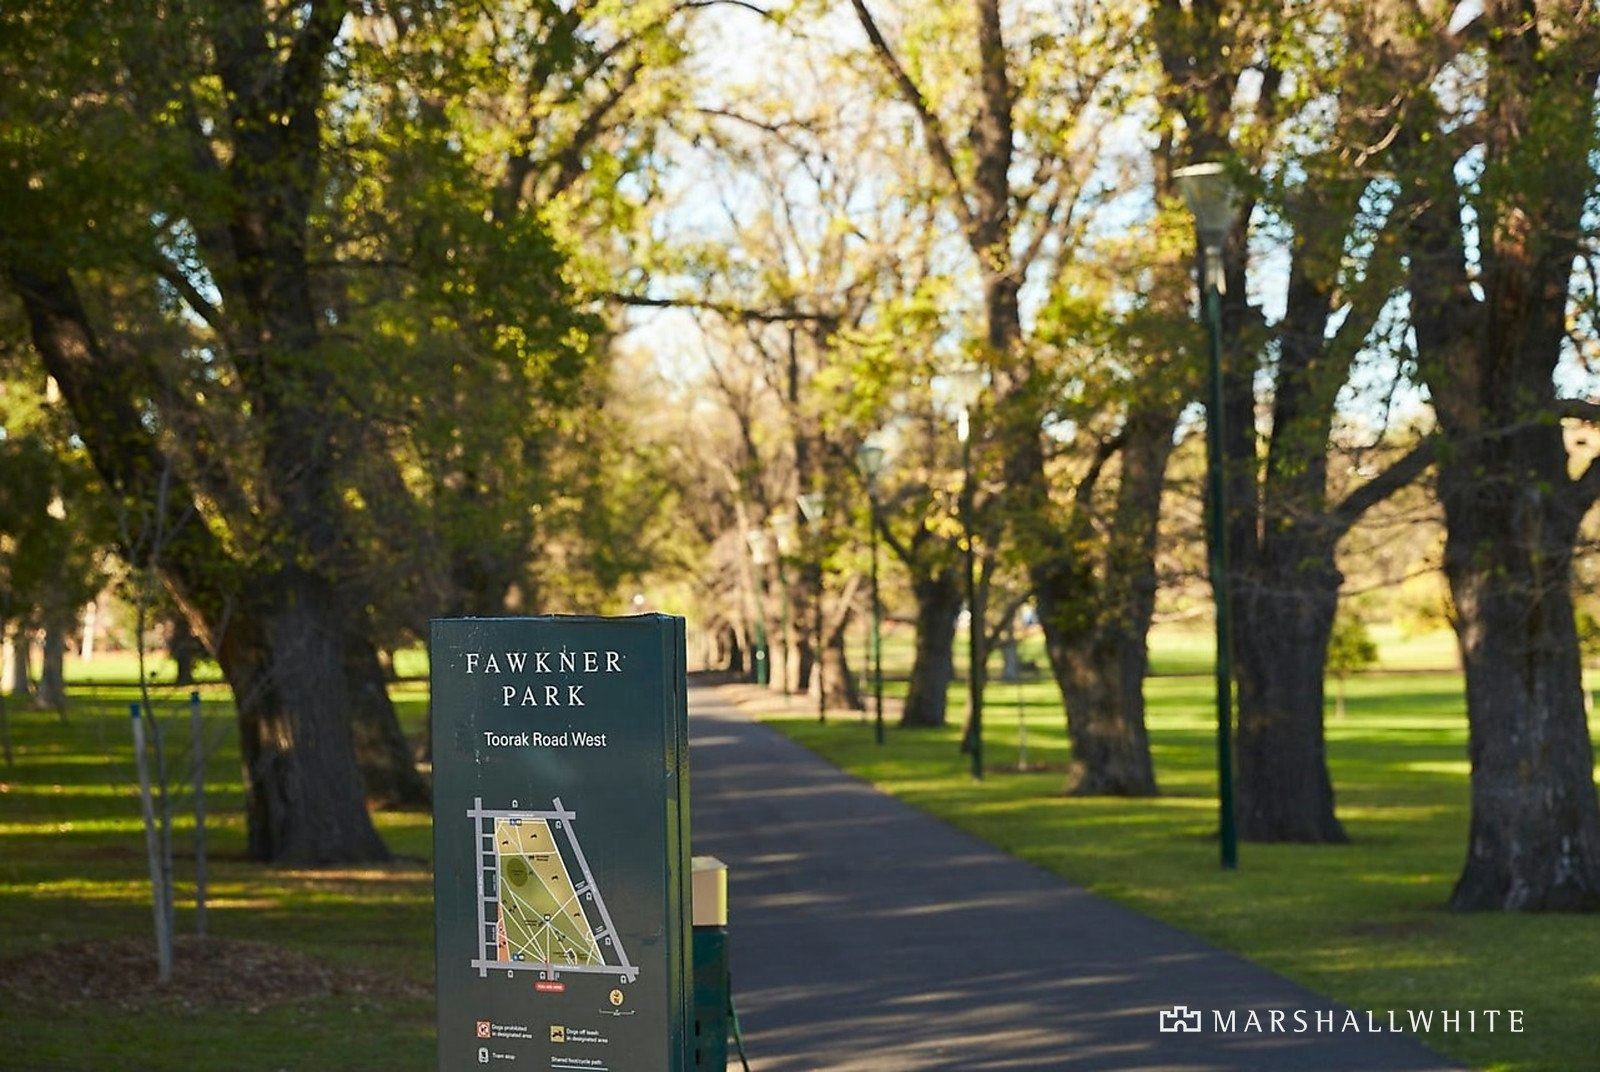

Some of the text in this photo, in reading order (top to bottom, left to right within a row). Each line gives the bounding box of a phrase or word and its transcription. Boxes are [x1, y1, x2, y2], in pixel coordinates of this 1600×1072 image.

[465, 651, 622, 674] FAWKNER
[502, 685, 585, 706] PARK
[484, 731, 607, 747] Toorak Road West
